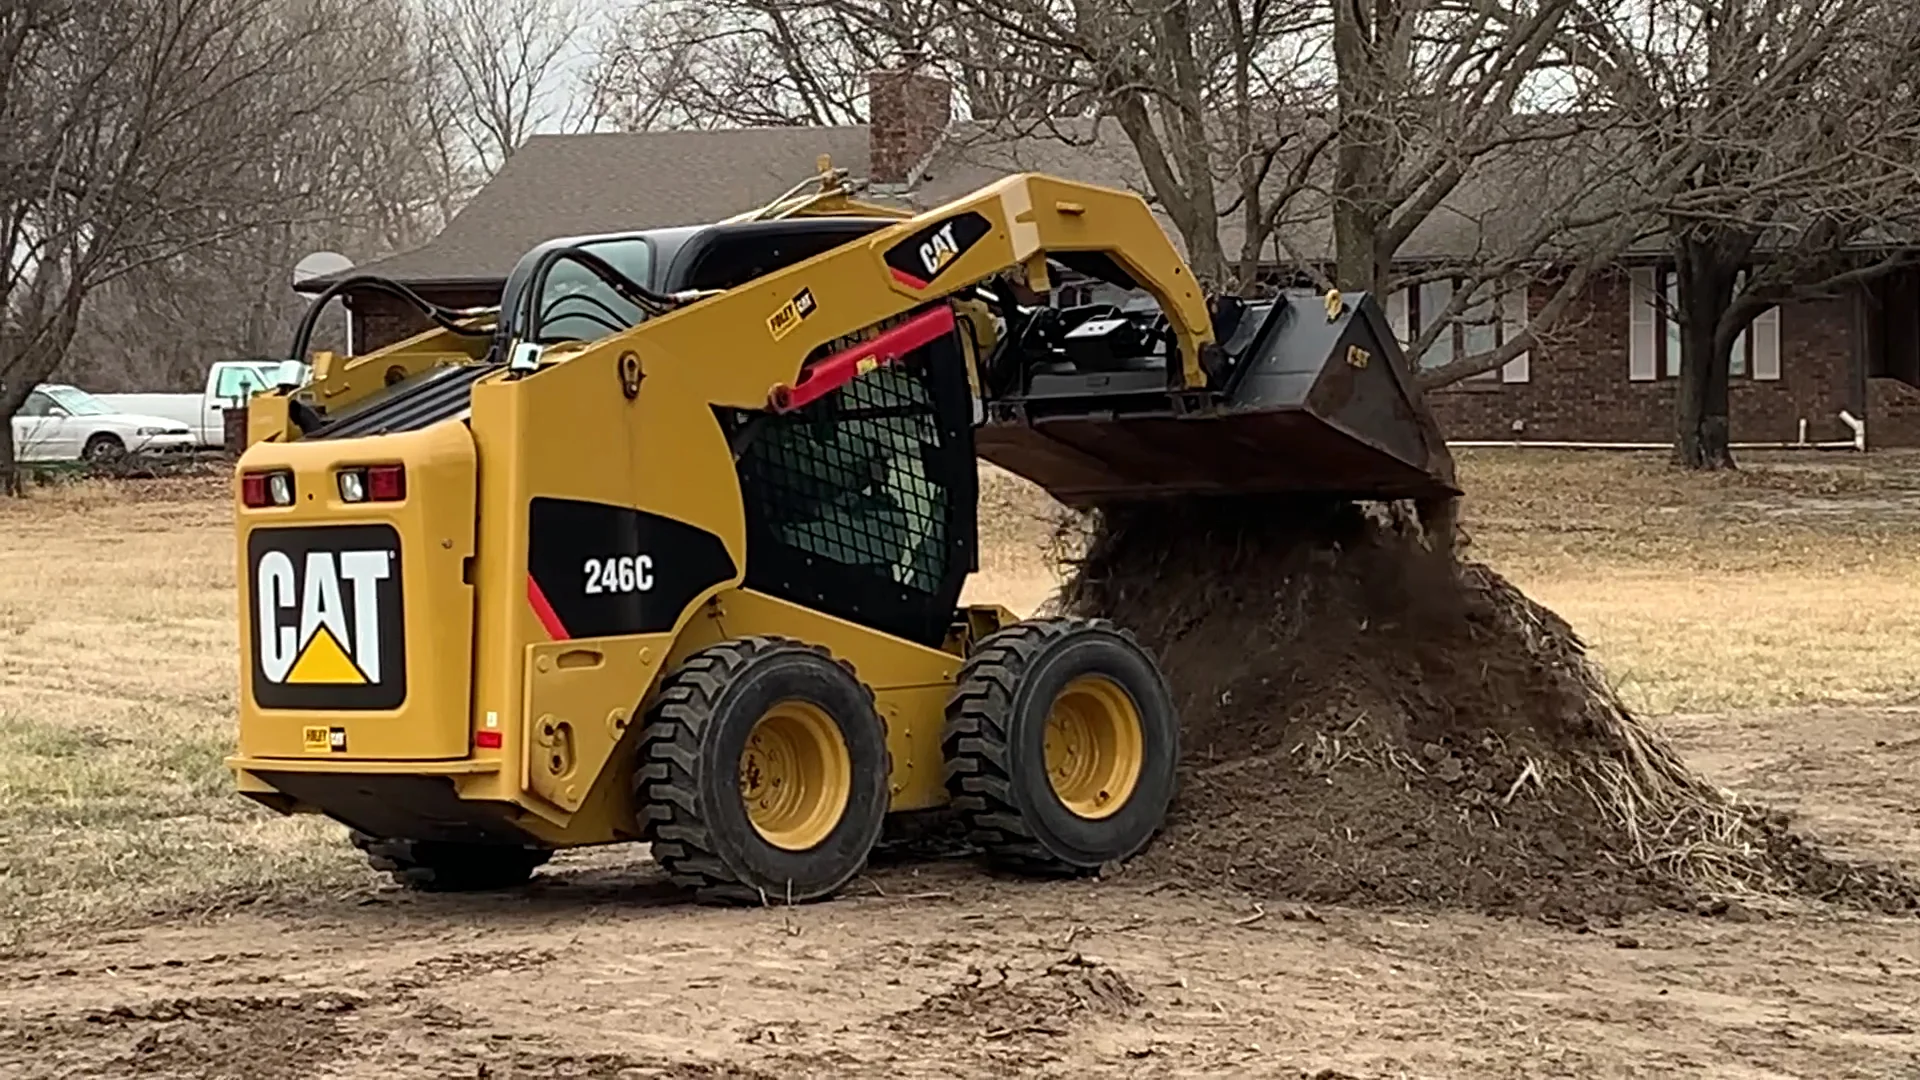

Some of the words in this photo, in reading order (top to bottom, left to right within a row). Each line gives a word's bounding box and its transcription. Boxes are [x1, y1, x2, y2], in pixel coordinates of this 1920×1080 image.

[919, 223, 959, 275] CAT
[796, 293, 812, 313] CAT
[584, 555, 654, 594] 246C
[258, 550, 391, 684] CAT
